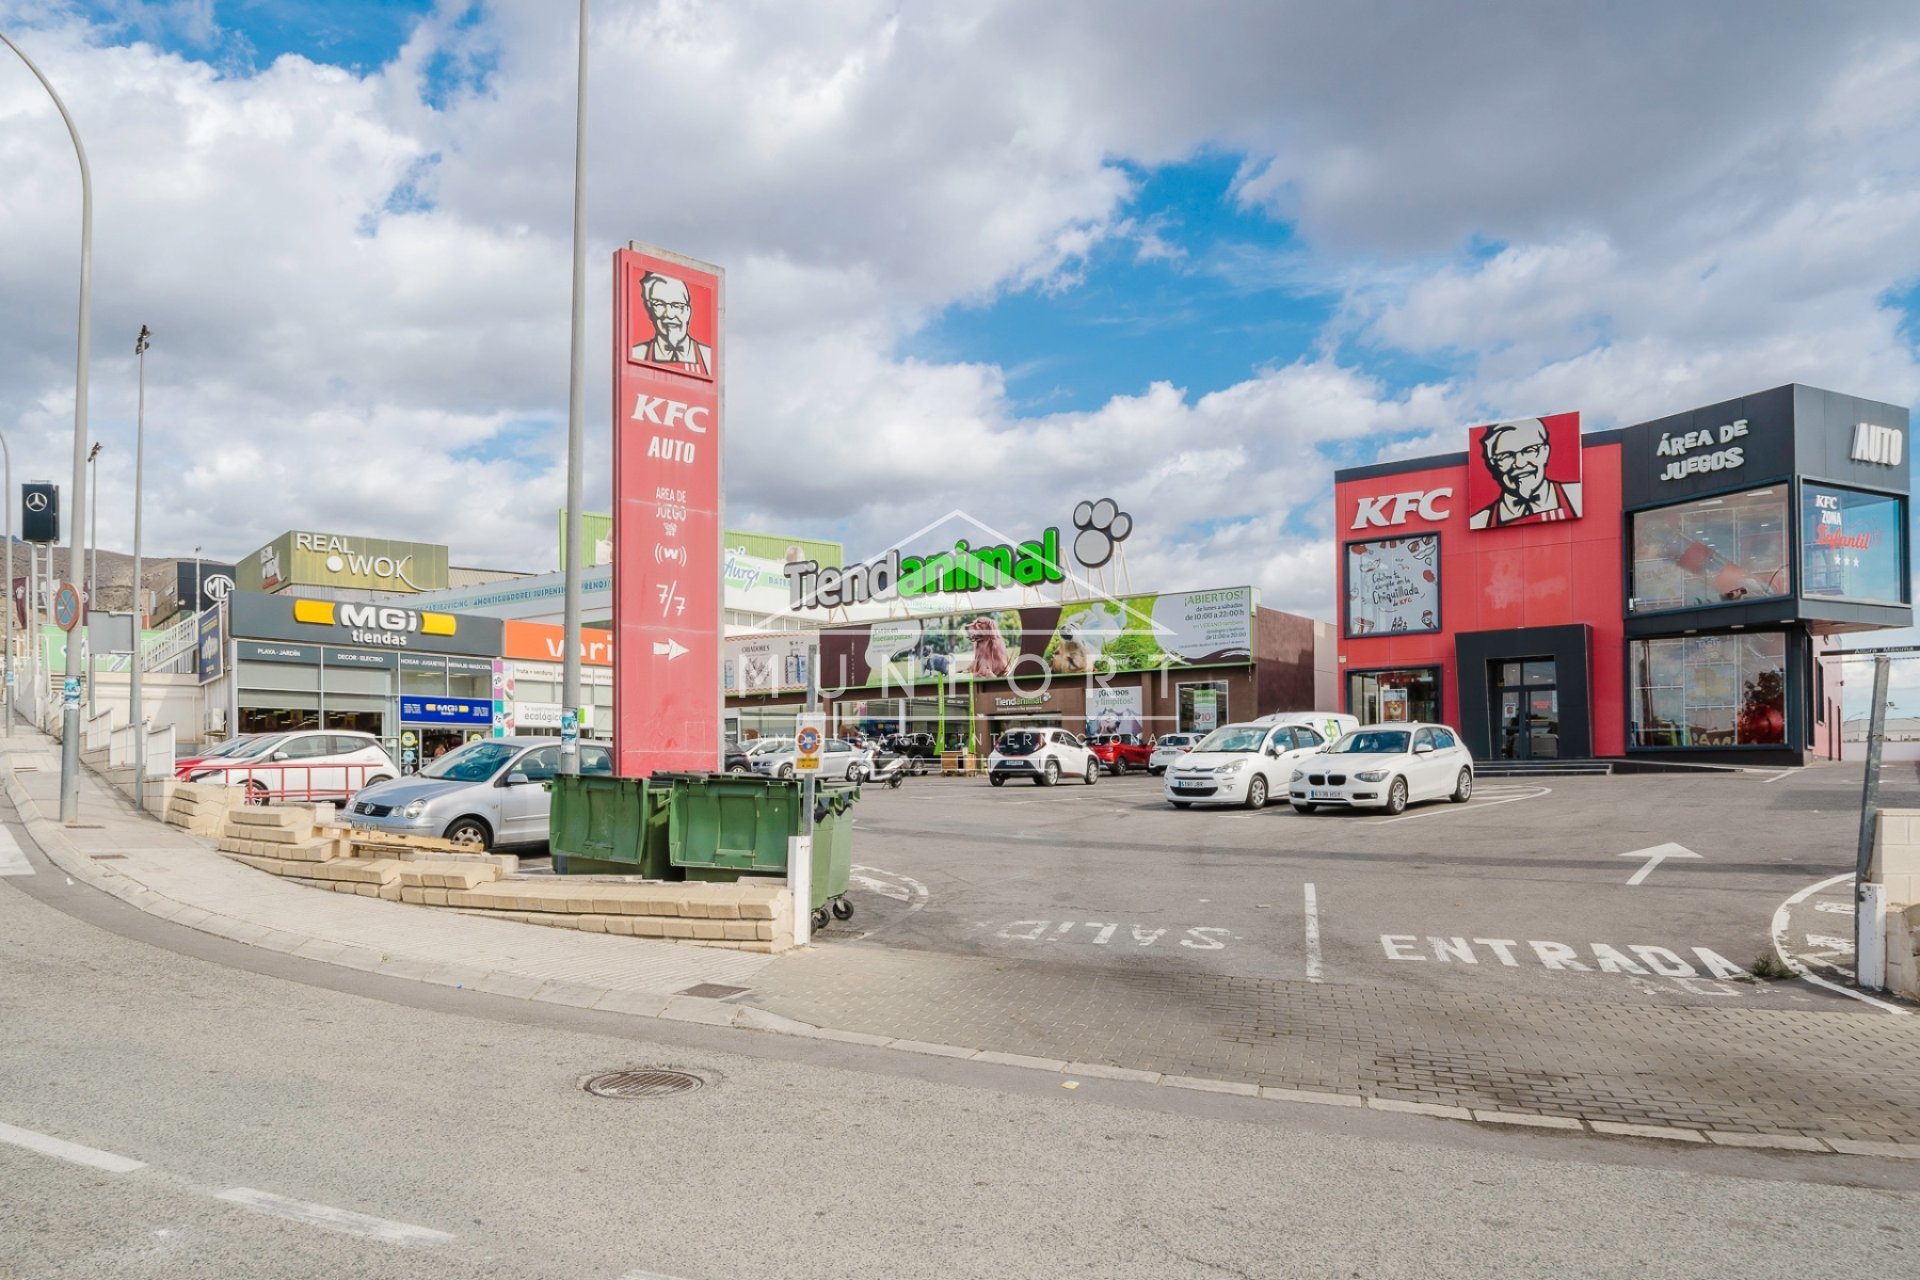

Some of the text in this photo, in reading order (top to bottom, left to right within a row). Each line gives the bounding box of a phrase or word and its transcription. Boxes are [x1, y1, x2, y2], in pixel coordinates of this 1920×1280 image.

[631, 393, 709, 433] KFC
[648, 436, 695, 464] AUTO
[1657, 419, 1748, 457] ÁREA DE
[1851, 422, 1902, 466] AUTO
[1660, 447, 1744, 481] JUEGOS
[656, 487, 686, 502] AREA DE
[1351, 488, 1453, 530] KFC
[1816, 494, 1837, 509] KFC
[656, 503, 686, 521] JUEGO
[296, 533, 354, 555] REAL
[784, 526, 1066, 611] Tiendanimal
[656, 580, 686, 617] 7/7
[1185, 590, 1243, 607] ¡ABIERTOS!
[351, 630, 408, 646] tiendas
[975, 920, 1232, 950] SALID
[1379, 934, 1748, 980] ENTRADA
